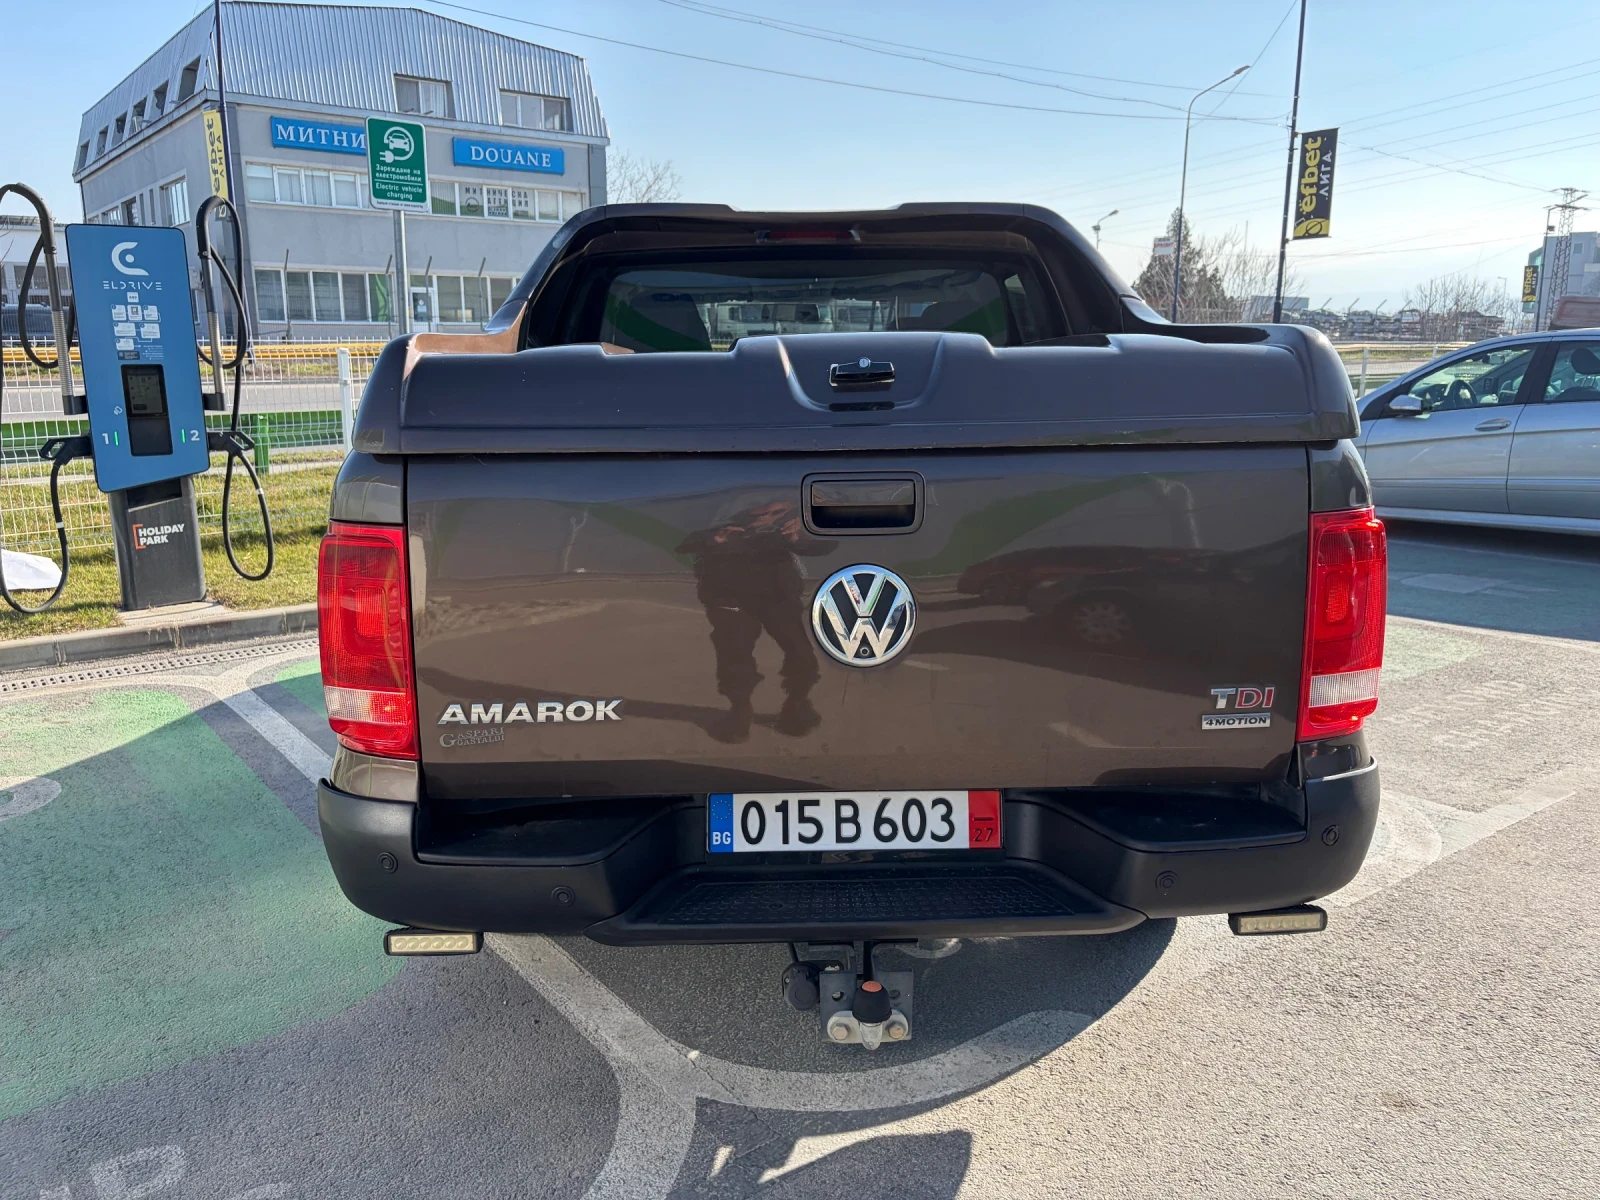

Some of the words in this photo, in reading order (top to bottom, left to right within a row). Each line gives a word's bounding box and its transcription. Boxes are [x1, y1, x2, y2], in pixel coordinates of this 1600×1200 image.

[206, 118, 221, 196] efbet
[470, 145, 552, 168] DOUANE
[376, 164, 411, 174] Зареждане
[1301, 136, 1322, 213] efbet
[1319, 151, 1333, 199] ЛИГА
[376, 173, 422, 181] електромобили
[386, 191, 413, 200] charging
[102, 280, 162, 291] ELDRIVE
[101, 433, 110, 445] 1
[189, 430, 200, 442] 2
[138, 523, 185, 537] HOLIDAY
[139, 534, 169, 546] PARK
[815, 565, 913, 665] VW
[1210, 687, 1275, 709] TDI
[437, 699, 623, 725] AMAROK
[1205, 716, 1267, 726] 4MOTION
[712, 831, 732, 845] BG
[973, 828, 994, 842] 27
